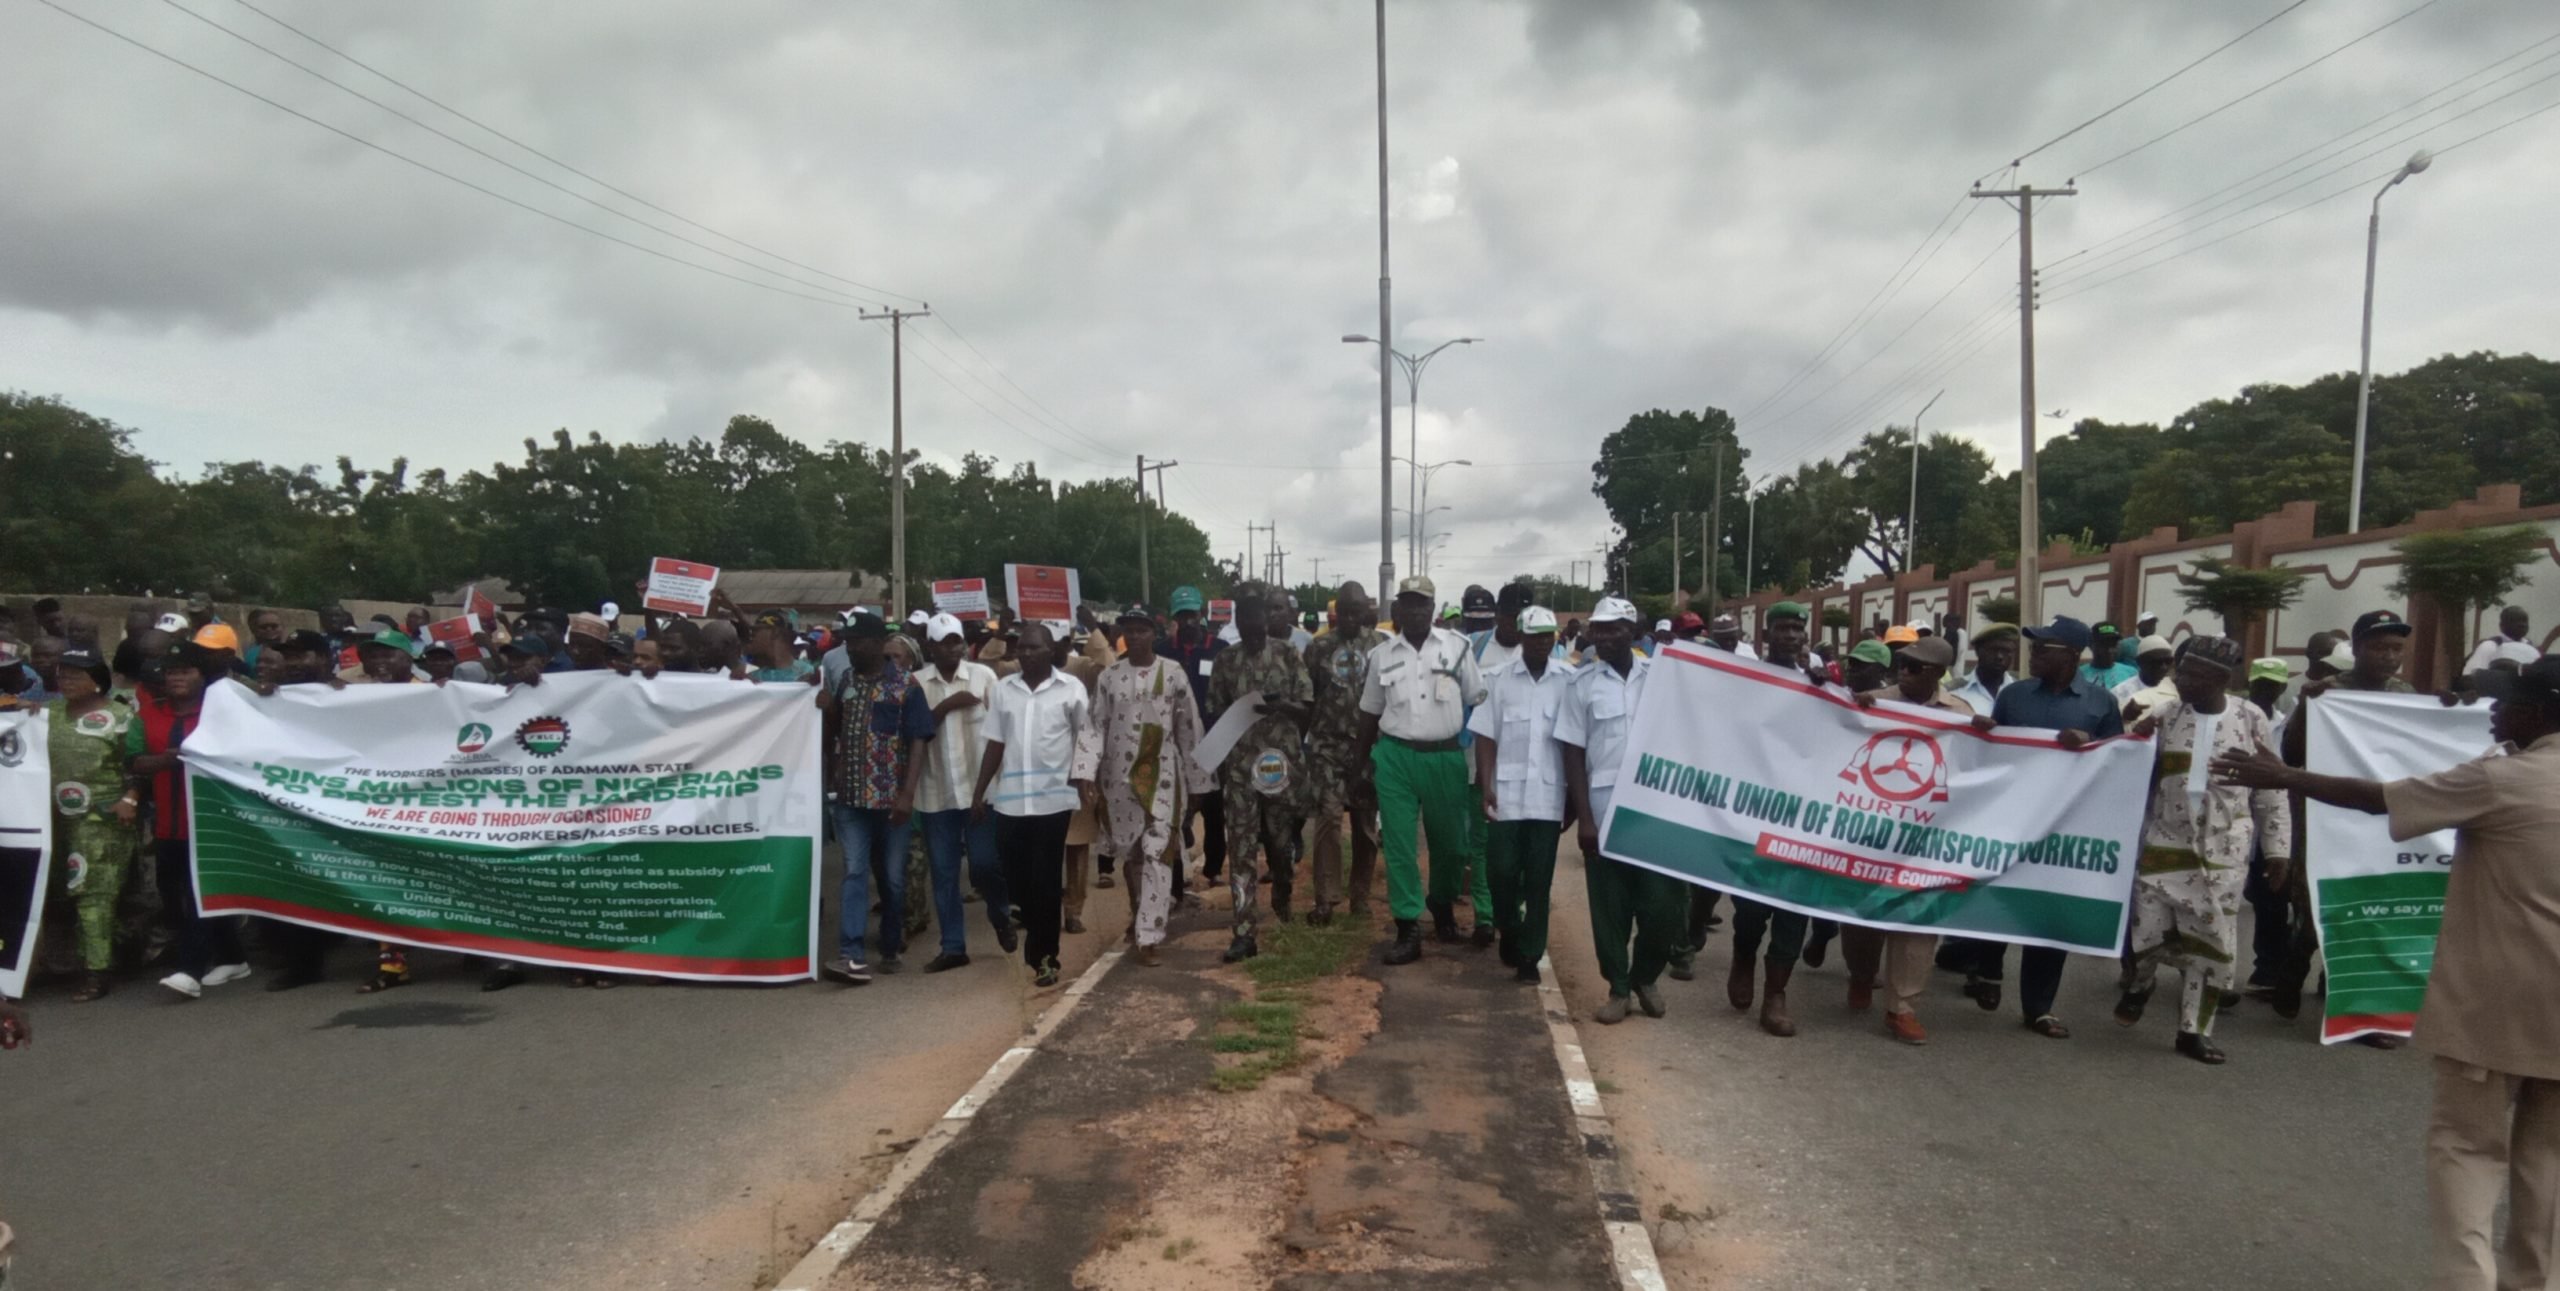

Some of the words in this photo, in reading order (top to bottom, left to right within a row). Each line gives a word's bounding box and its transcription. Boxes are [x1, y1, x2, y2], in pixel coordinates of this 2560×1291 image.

[344, 767, 372, 777] THE
[377, 767, 446, 779] WORKERS
[451, 765, 524, 779] (MASSES)
[529, 765, 548, 775] OF
[552, 763, 640, 775] ADAMAWA
[644, 762, 694, 774] STATE
[358, 778, 527, 795] MILLIONS
[538, 778, 583, 793] OF
[595, 764, 784, 793] NIGERIANS
[264, 776, 309, 794] TO
[321, 788, 488, 808] PROTEST
[499, 793, 574, 808] THE
[579, 782, 760, 807] HARDSHIP
[366, 807, 388, 819] WE
[393, 809, 425, 823] ARE
[430, 810, 477, 827] GOING
[482, 811, 550, 828] THROUGH
[552, 807, 652, 824] OCCASIONED
[1634, 752, 1731, 810] NATIONAL
[1732, 781, 1803, 828] UNION
[1801, 800, 1833, 835] OF
[1830, 809, 1894, 851] ROAD
[1893, 821, 2018, 873] TRANSPORT
[1835, 791, 1937, 825] NURTW
[435, 828, 481, 840] ANTI
[486, 825, 660, 843] WORKERS/MASSES
[665, 822, 760, 836] POLICIES.
[492, 864, 558, 876] products
[562, 867, 576, 876] in
[580, 866, 644, 878] disguise
[647, 867, 664, 876] as
[667, 865, 726, 878] subsidy
[557, 853, 603, 863] father
[606, 853, 644, 863] land.
[1766, 839, 1848, 872] ADAMAWA
[1851, 860, 1895, 884] STATE
[2396, 853, 2429, 865] BY
[293, 864, 321, 877] This
[324, 867, 338, 878] is
[341, 869, 368, 882] the
[371, 872, 407, 887] time
[410, 877, 425, 889] to
[569, 906, 598, 916] and
[601, 908, 660, 919] political
[311, 852, 376, 869] Workers
[379, 861, 410, 873] now
[536, 894, 580, 905] salary
[583, 896, 602, 905] on
[606, 896, 718, 908] transportation.
[527, 878, 557, 888] fees
[561, 879, 578, 889] of
[580, 880, 619, 892] unity
[623, 880, 683, 890] schools.
[372, 903, 384, 913] A
[387, 905, 440, 920] people
[443, 910, 492, 926] United
[494, 917, 519, 930] can
[564, 929, 582, 939] be
[585, 931, 649, 944] defeated
[402, 891, 452, 906] United
[455, 899, 476, 909] we
[478, 902, 516, 918] stand
[519, 913, 536, 923] on
[539, 915, 590, 929] August
[597, 920, 629, 931] 2nd.
[2361, 906, 2390, 916] We
[2393, 904, 2423, 915] say
